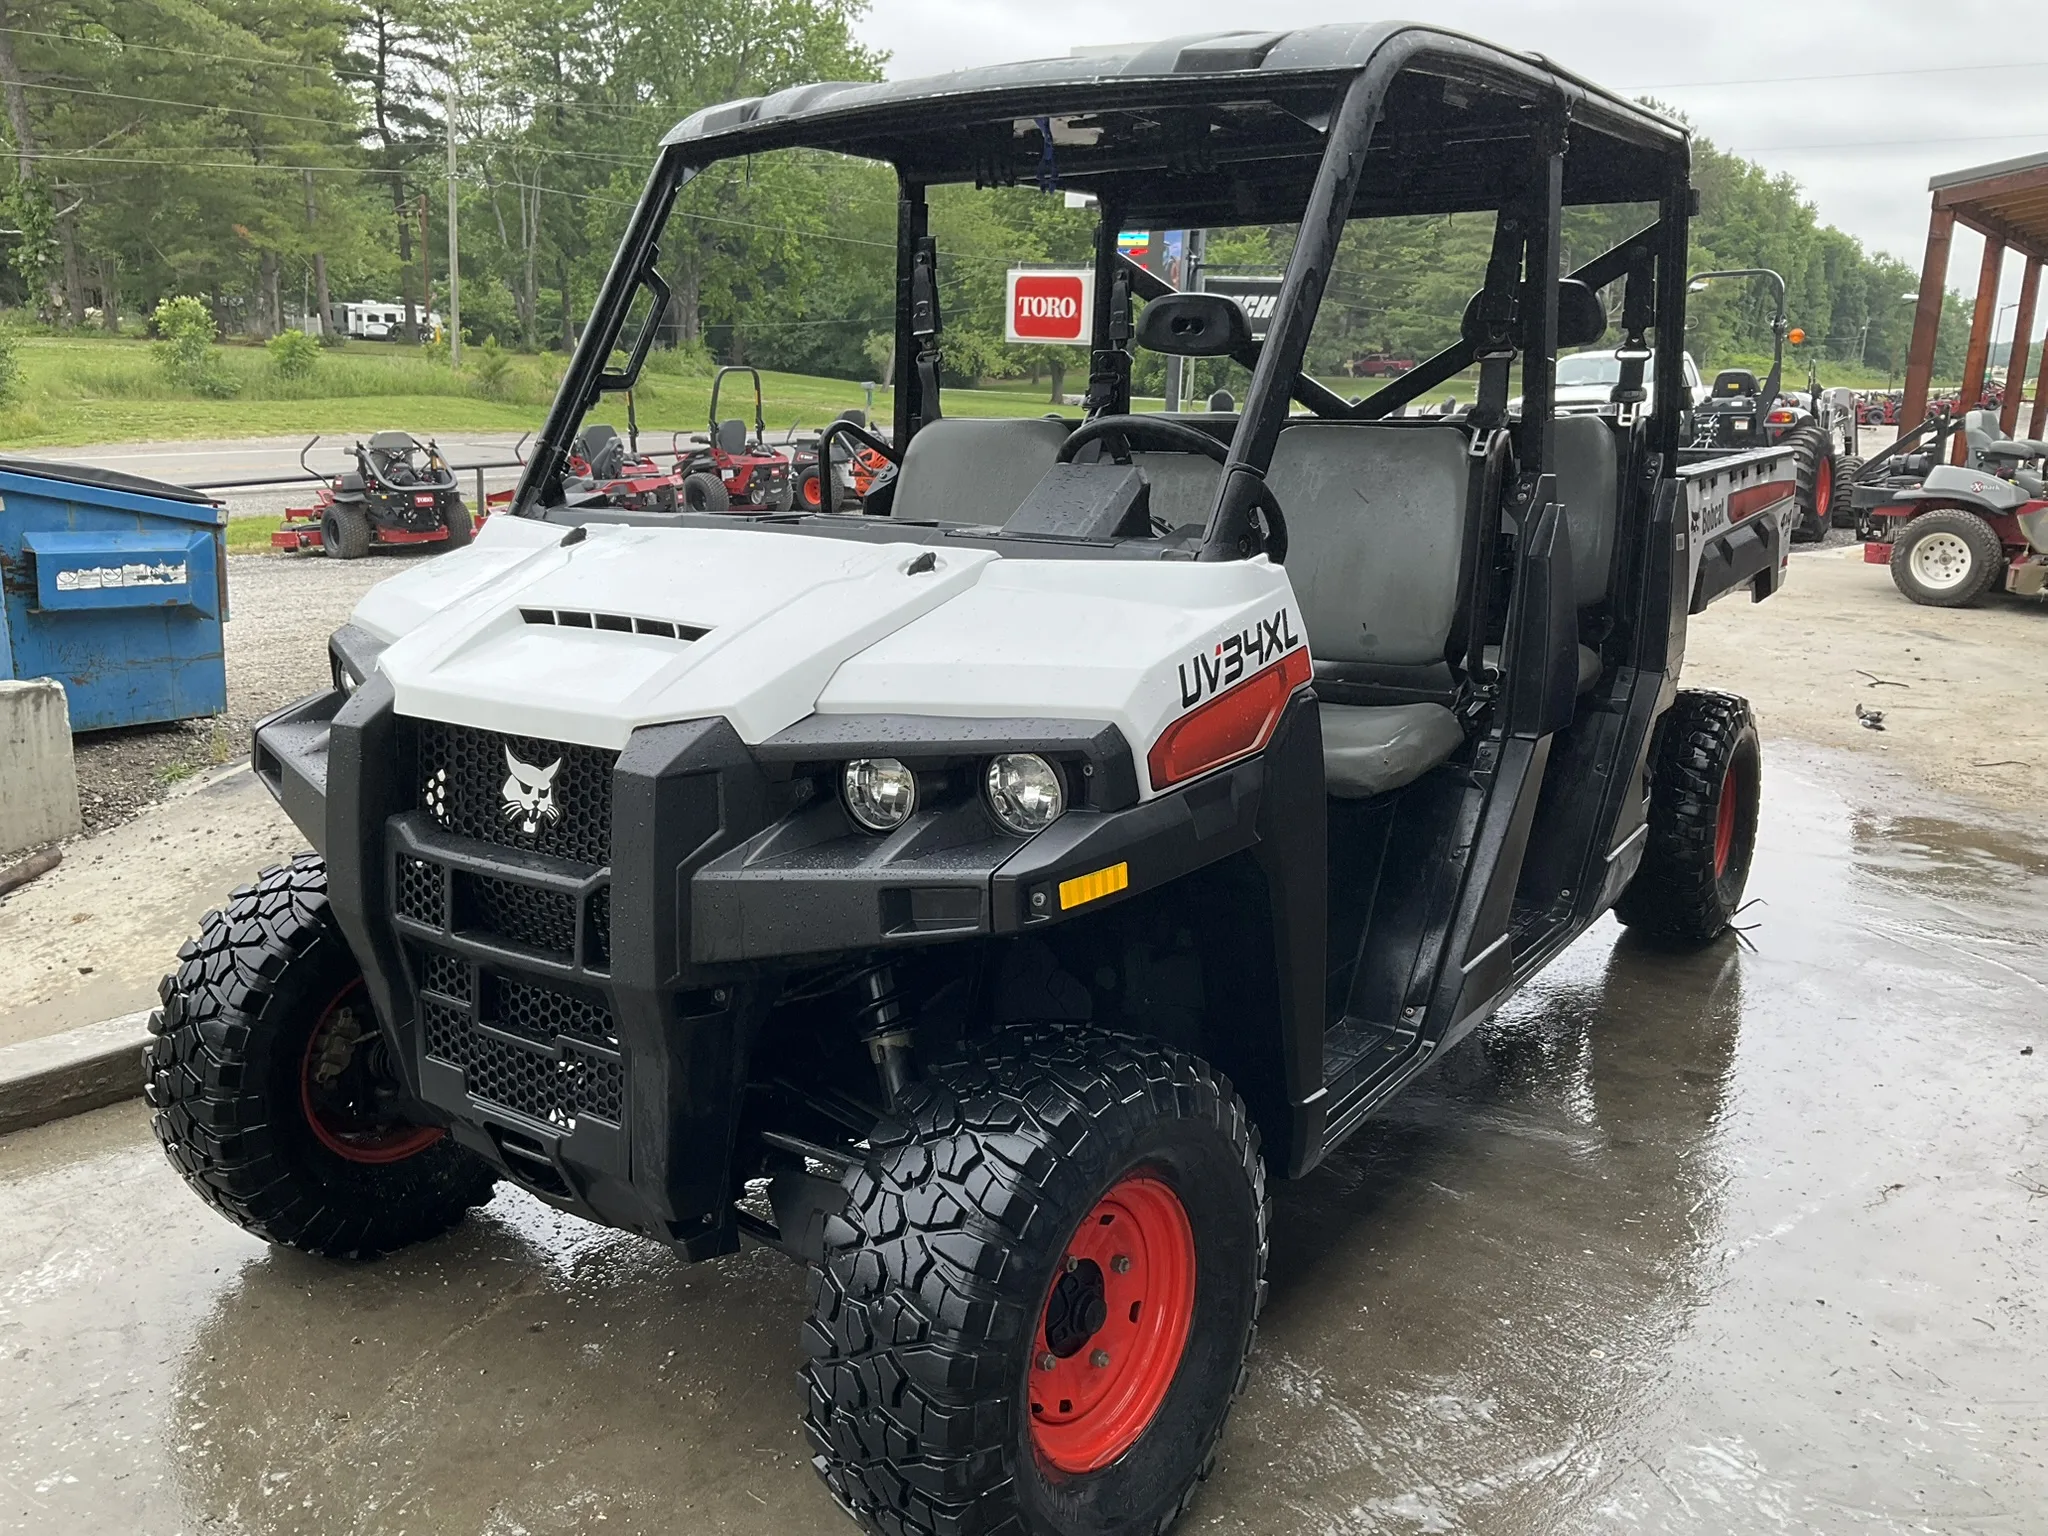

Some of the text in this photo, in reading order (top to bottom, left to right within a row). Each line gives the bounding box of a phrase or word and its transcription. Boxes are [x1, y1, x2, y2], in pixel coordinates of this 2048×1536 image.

[1018, 296, 1077, 318] TORO
[1702, 498, 1724, 536] Bobcat
[1178, 608, 1298, 709] UV34XL
